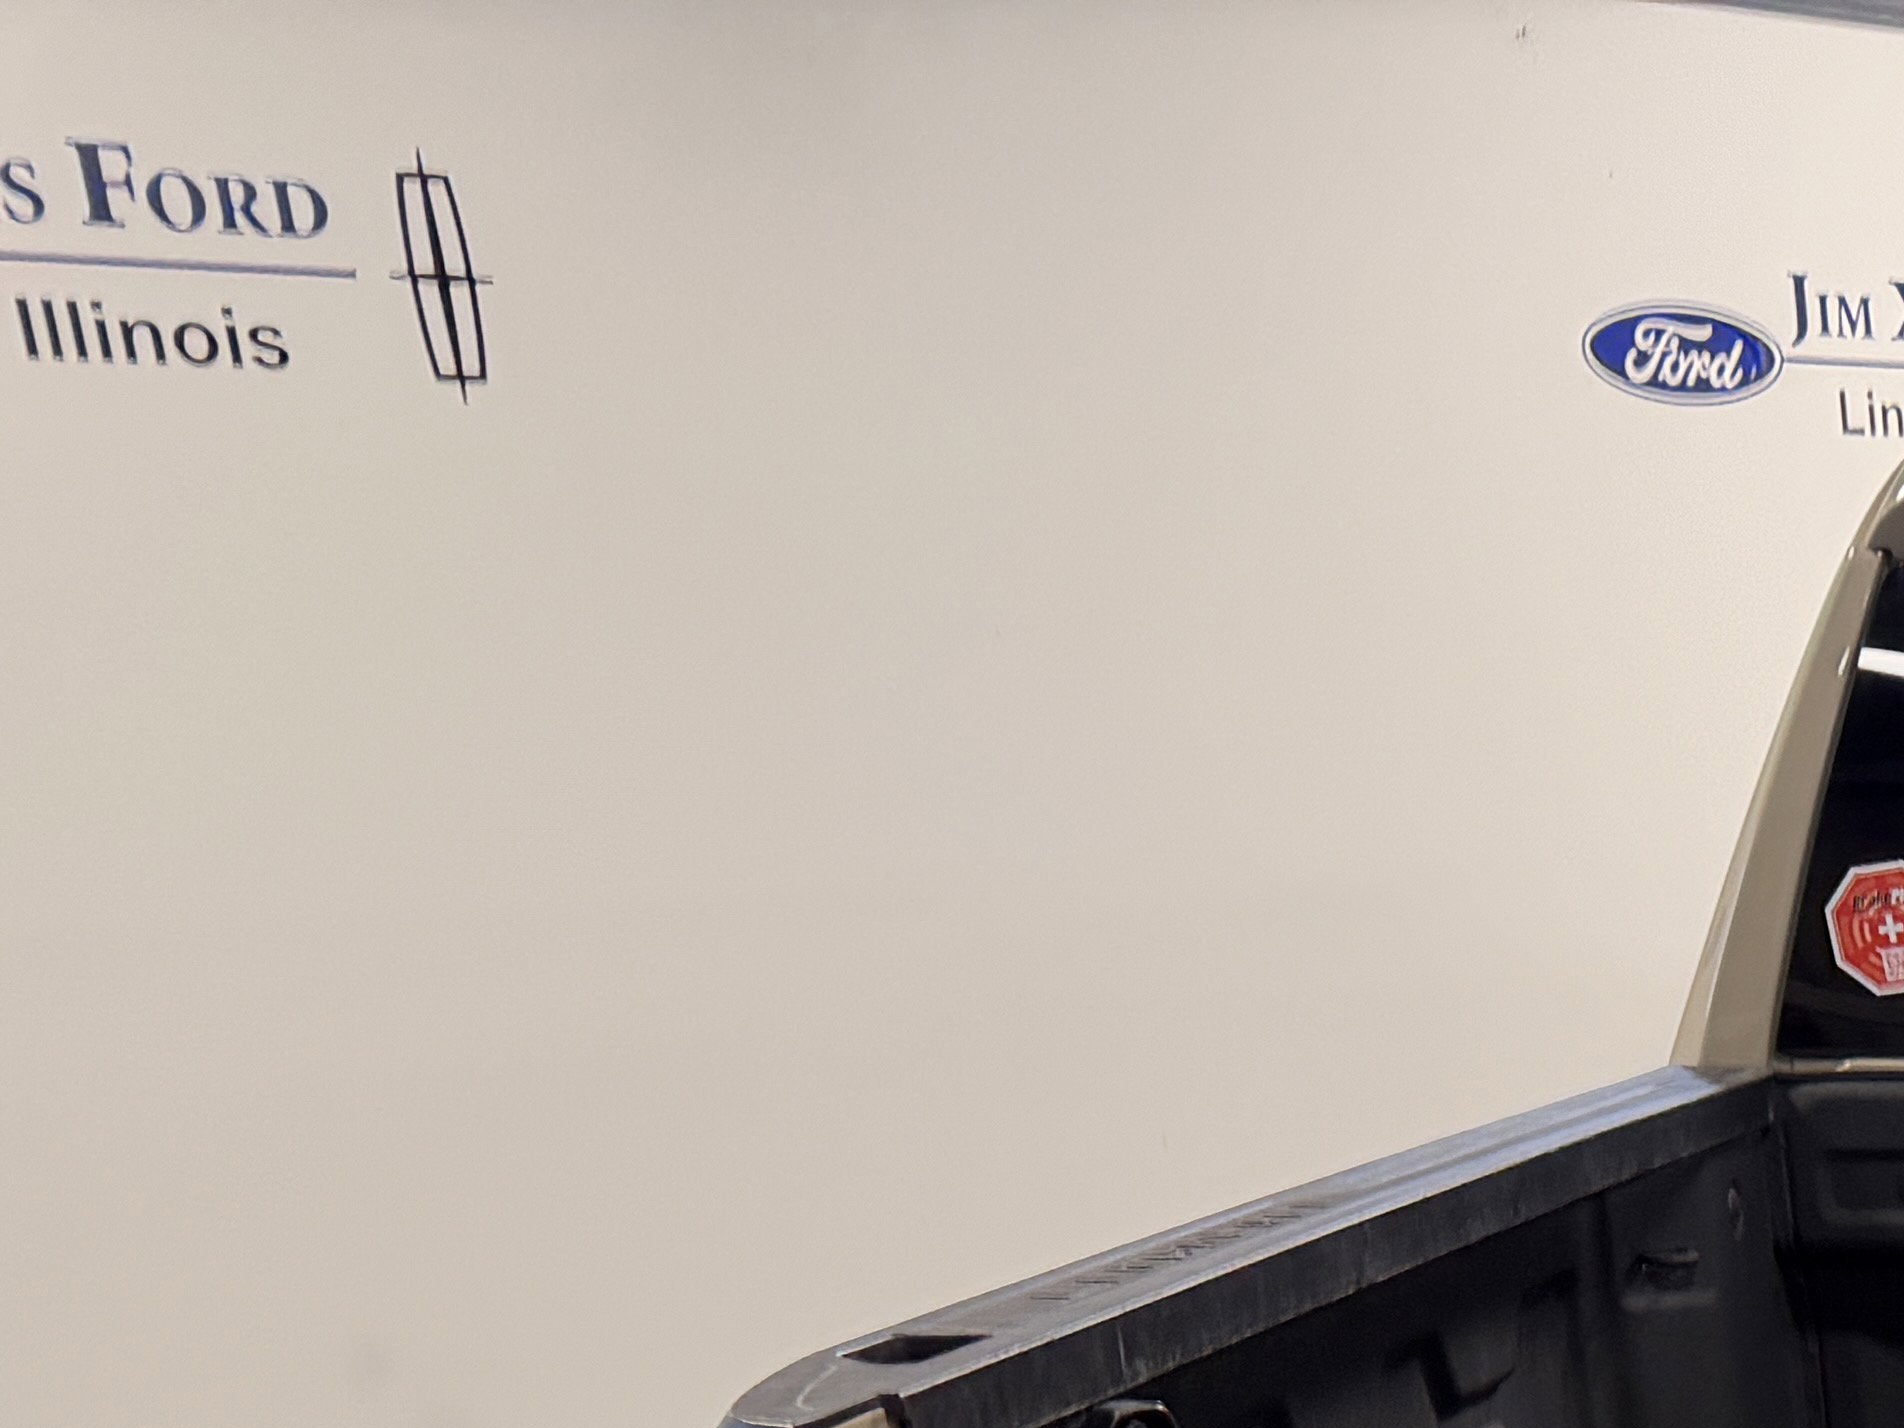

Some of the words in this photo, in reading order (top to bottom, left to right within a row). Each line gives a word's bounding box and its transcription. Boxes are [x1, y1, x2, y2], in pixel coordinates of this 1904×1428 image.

[65, 136, 328, 239] FORD
[15, 295, 290, 370] Illinois
[1788, 271, 1875, 348] JIM
[1624, 316, 1744, 389] Ford
